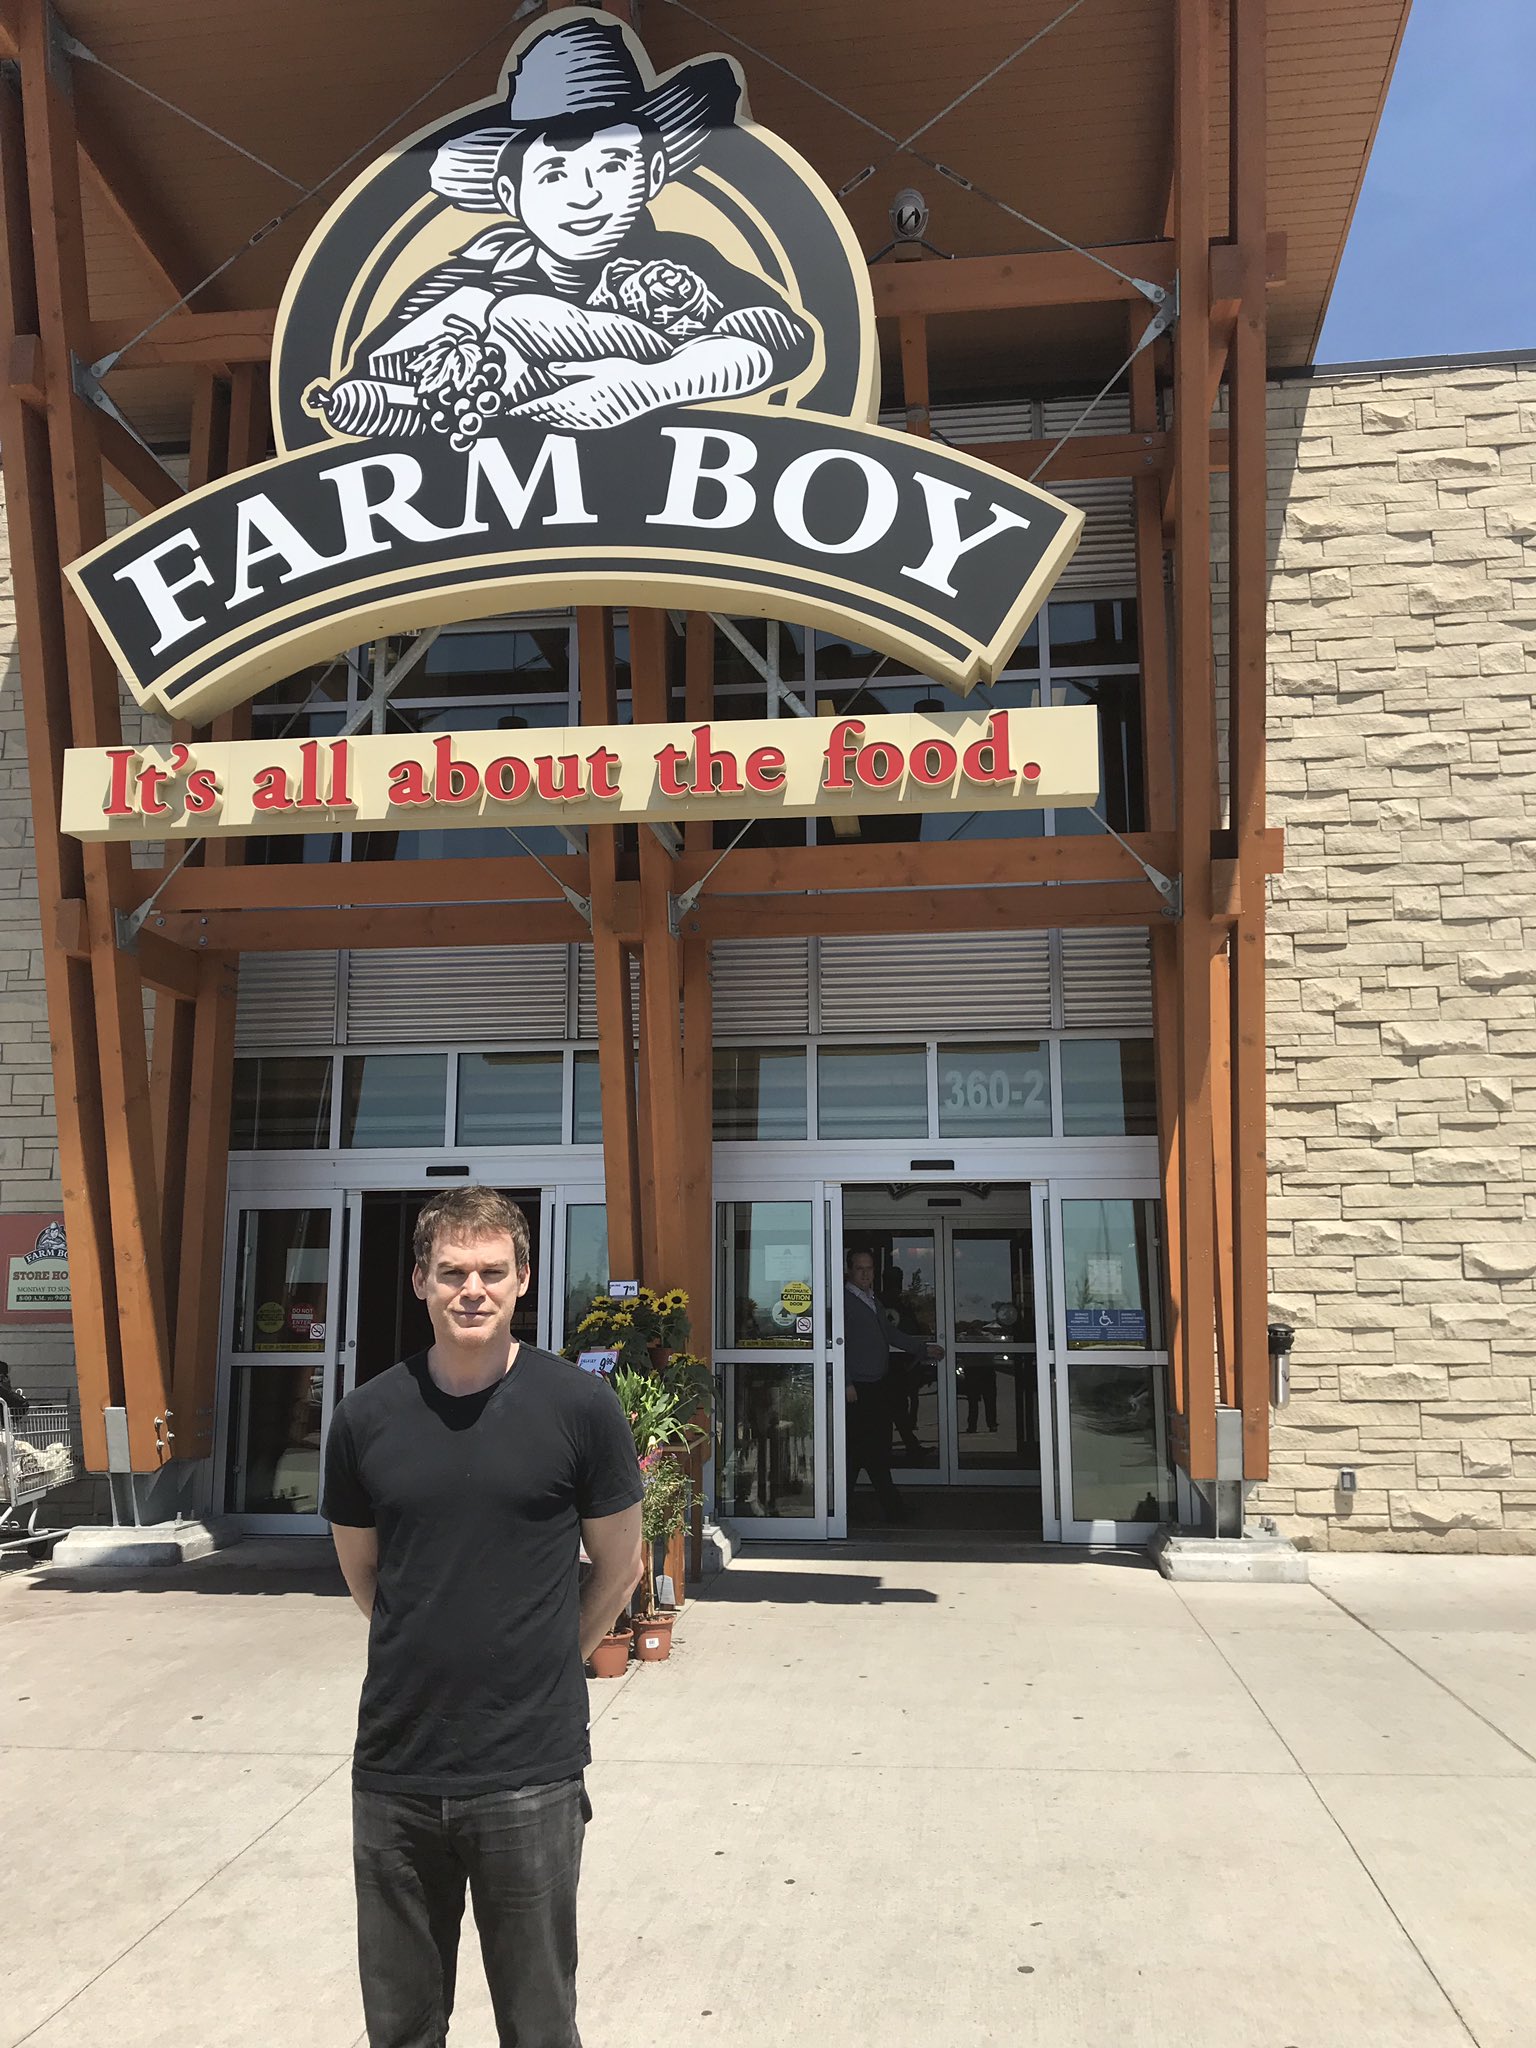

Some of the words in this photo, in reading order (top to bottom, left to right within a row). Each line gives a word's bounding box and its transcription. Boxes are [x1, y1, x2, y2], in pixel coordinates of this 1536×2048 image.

[113, 434, 598, 656] FARM
[646, 427, 1030, 599] BOY
[102, 742, 219, 817] It's
[252, 741, 355, 810] all
[388, 735, 620, 804] about
[654, 725, 787, 796] the
[823, 711, 1042, 790] food.
[944, 1069, 1045, 1111] 360-2
[13, 1271, 50, 1280] STORE
[26, 1249, 54, 1262] FARM
[57, 1249, 68, 1259] BO
